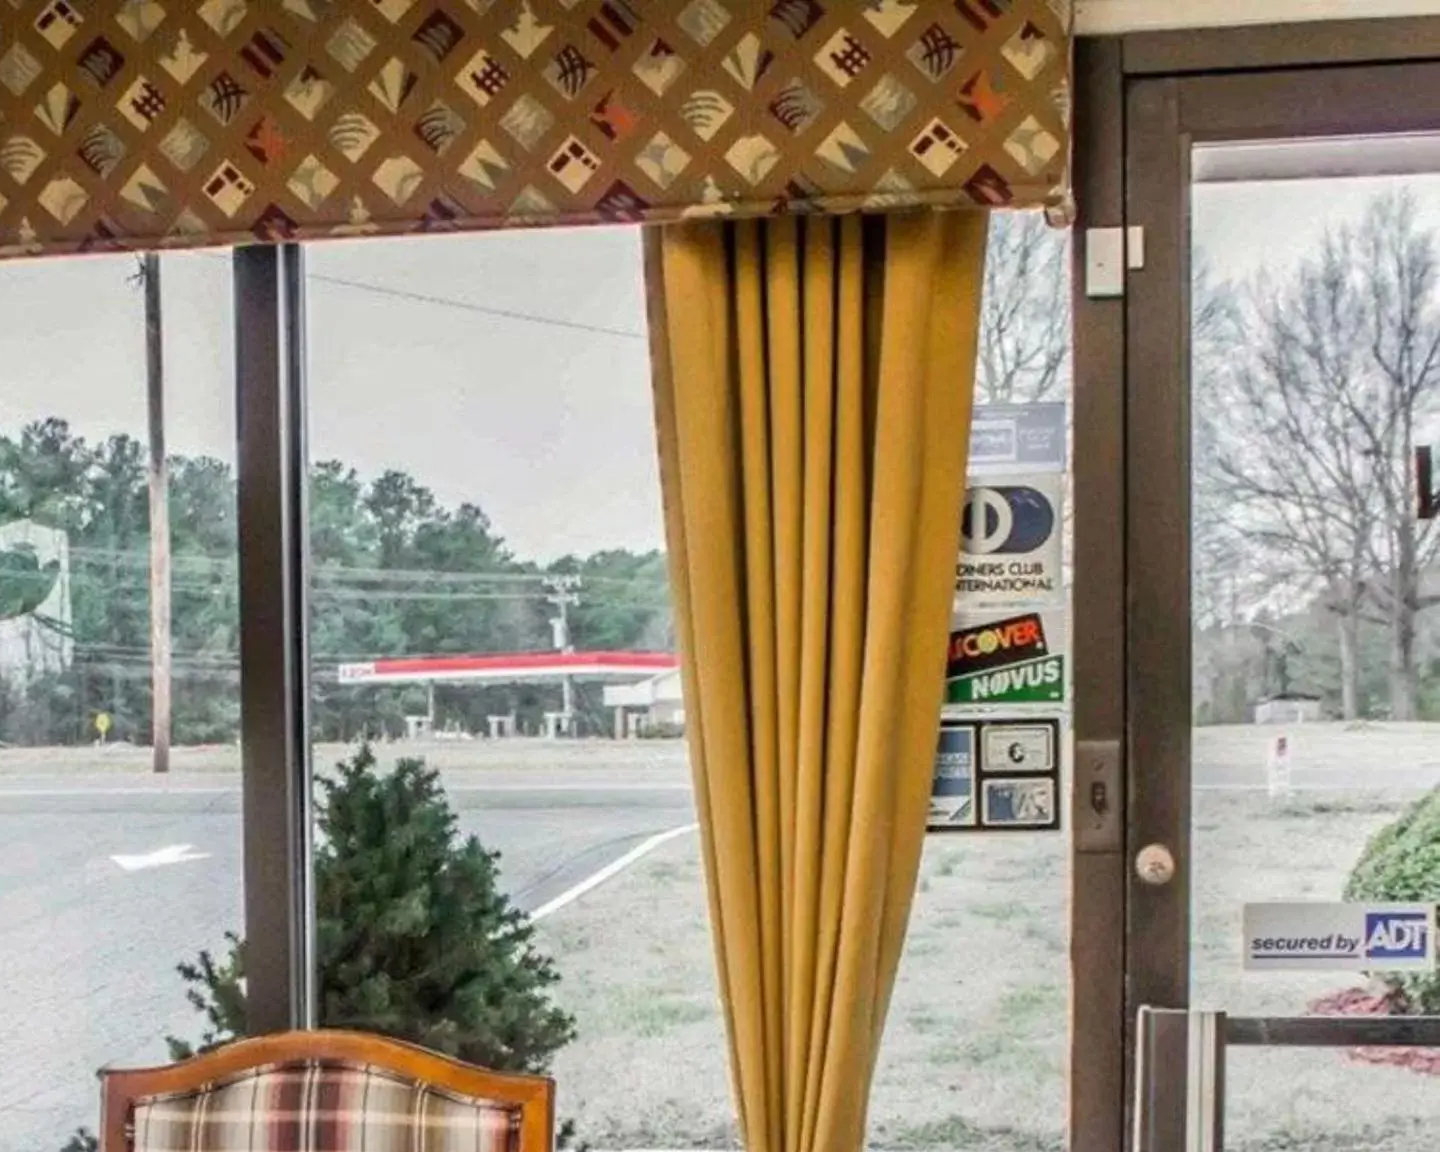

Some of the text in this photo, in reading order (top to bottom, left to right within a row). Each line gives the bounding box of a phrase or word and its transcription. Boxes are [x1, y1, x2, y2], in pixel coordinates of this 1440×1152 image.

[1008, 562, 1044, 576] CLUB
[971, 660, 1060, 700] NOVUS
[1252, 919, 1427, 953] secured by ADT
